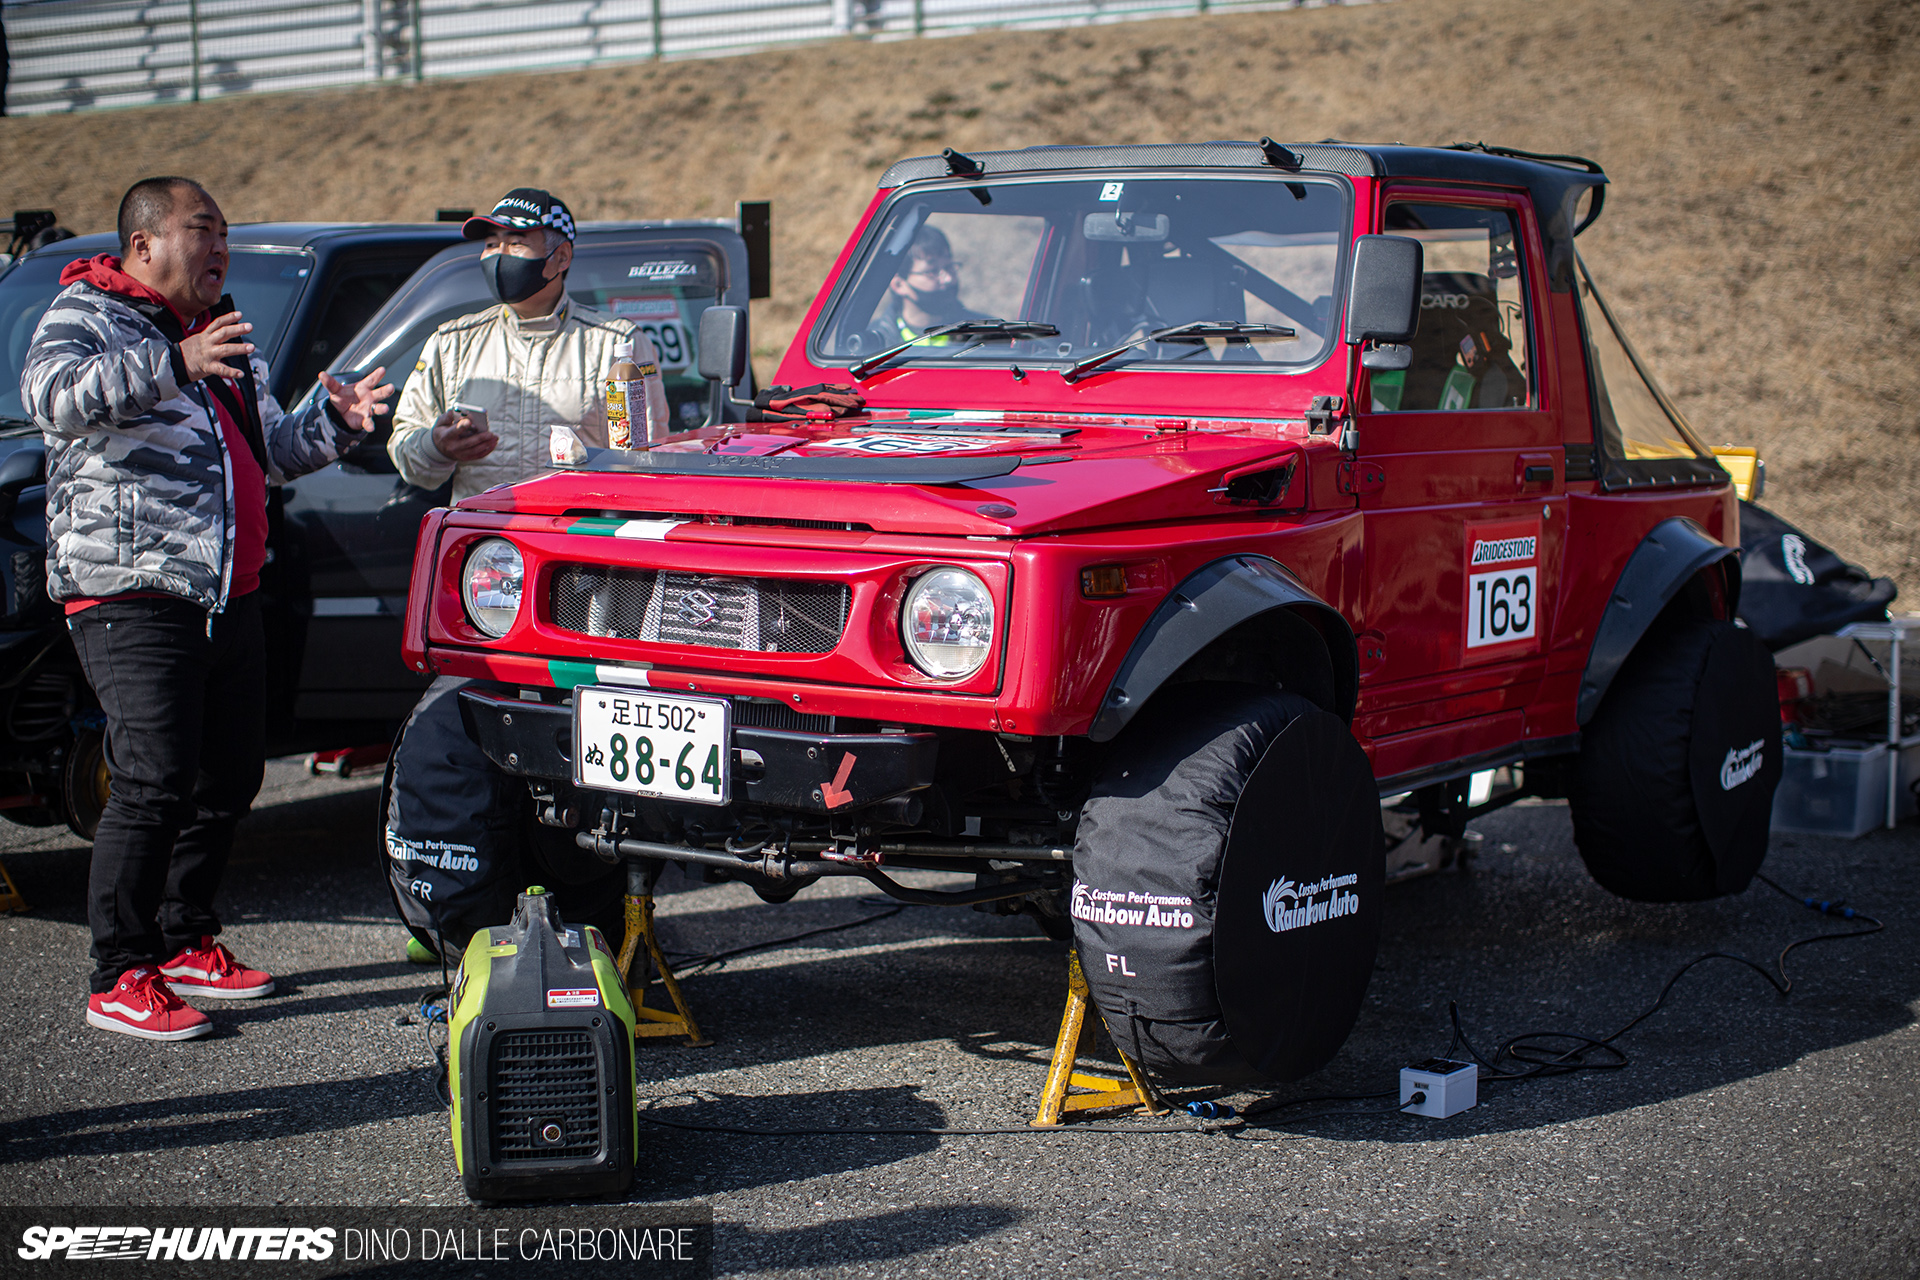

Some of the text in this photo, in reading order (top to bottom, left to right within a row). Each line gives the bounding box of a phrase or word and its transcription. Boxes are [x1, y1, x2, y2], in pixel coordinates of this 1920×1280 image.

[1109, 184, 1118, 195] 2
[491, 198, 541, 216] OHAMA
[628, 264, 698, 278] BELLEZZA
[707, 455, 794, 469] SPORT
[1472, 538, 1536, 563] BRIDGESTONE
[1477, 574, 1531, 639] 163
[612, 699, 696, 733] 足立 502
[585, 733, 721, 794] ぬ 88-64
[425, 840, 477, 853] Performance
[439, 850, 479, 872] Auto
[410, 879, 432, 901] FR
[1320, 873, 1358, 892] Performance
[1092, 888, 1193, 906] Custom Performance
[1074, 895, 1194, 928] Rainbow Auto
[1274, 889, 1359, 933] Rainbow Auto
[1105, 953, 1136, 977] FL
